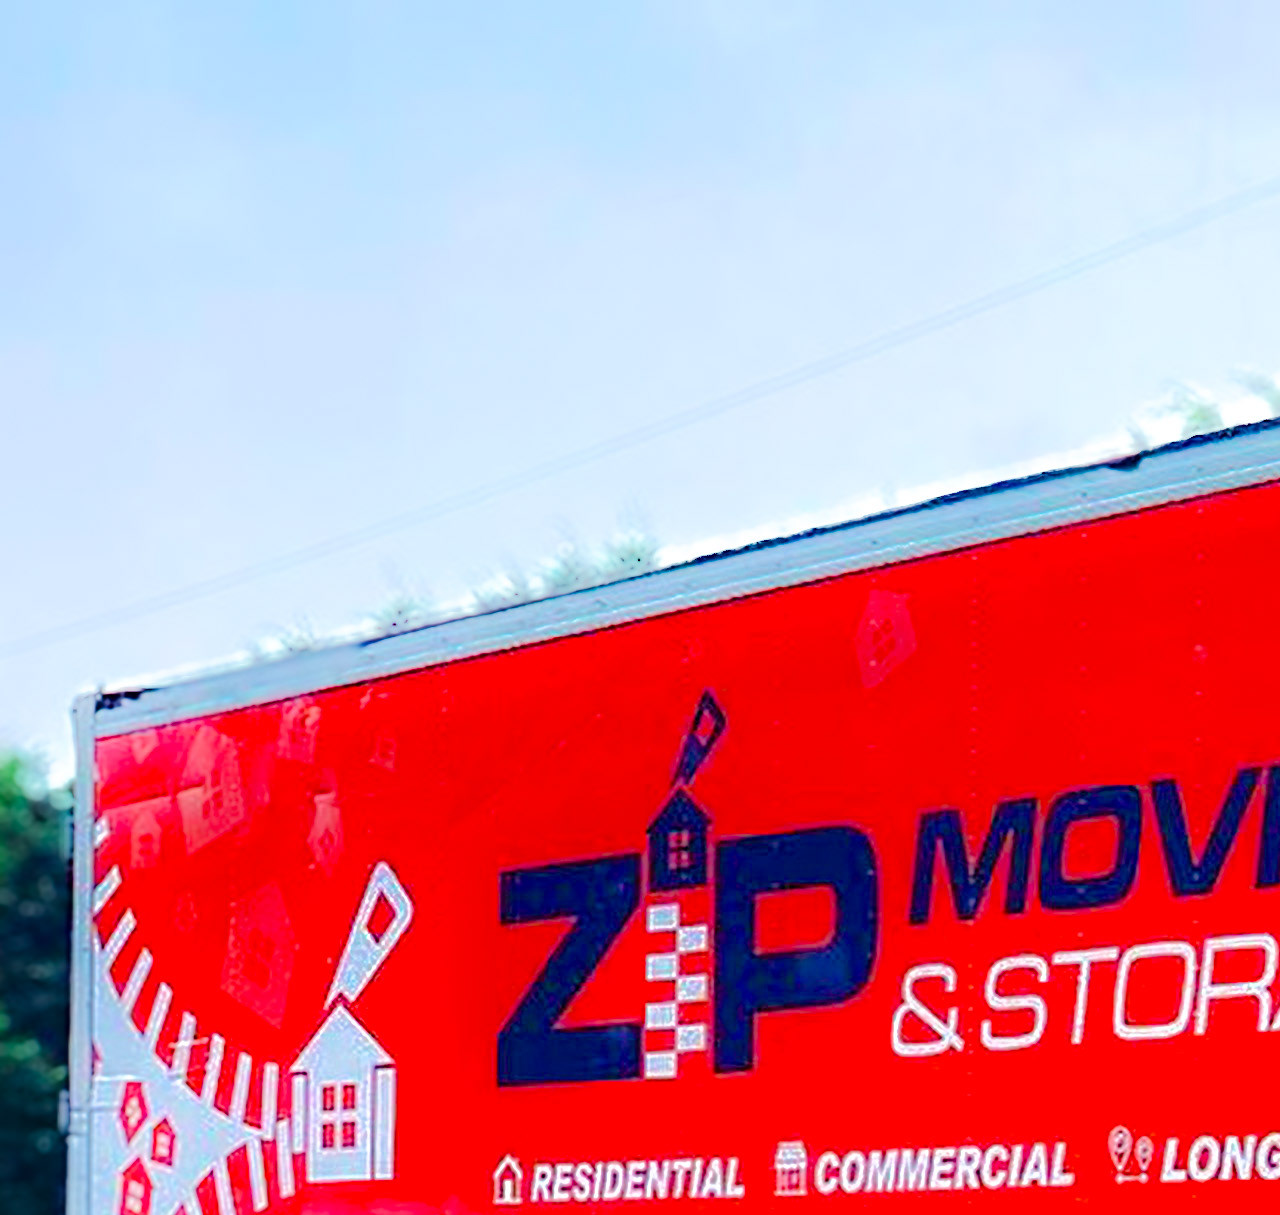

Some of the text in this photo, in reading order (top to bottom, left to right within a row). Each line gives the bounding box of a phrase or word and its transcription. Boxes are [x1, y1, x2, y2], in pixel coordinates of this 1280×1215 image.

[891, 963, 964, 1056] &
[531, 1158, 745, 1202] RESIDENTIAL
[814, 1142, 1075, 1194] COMMERCIAL
